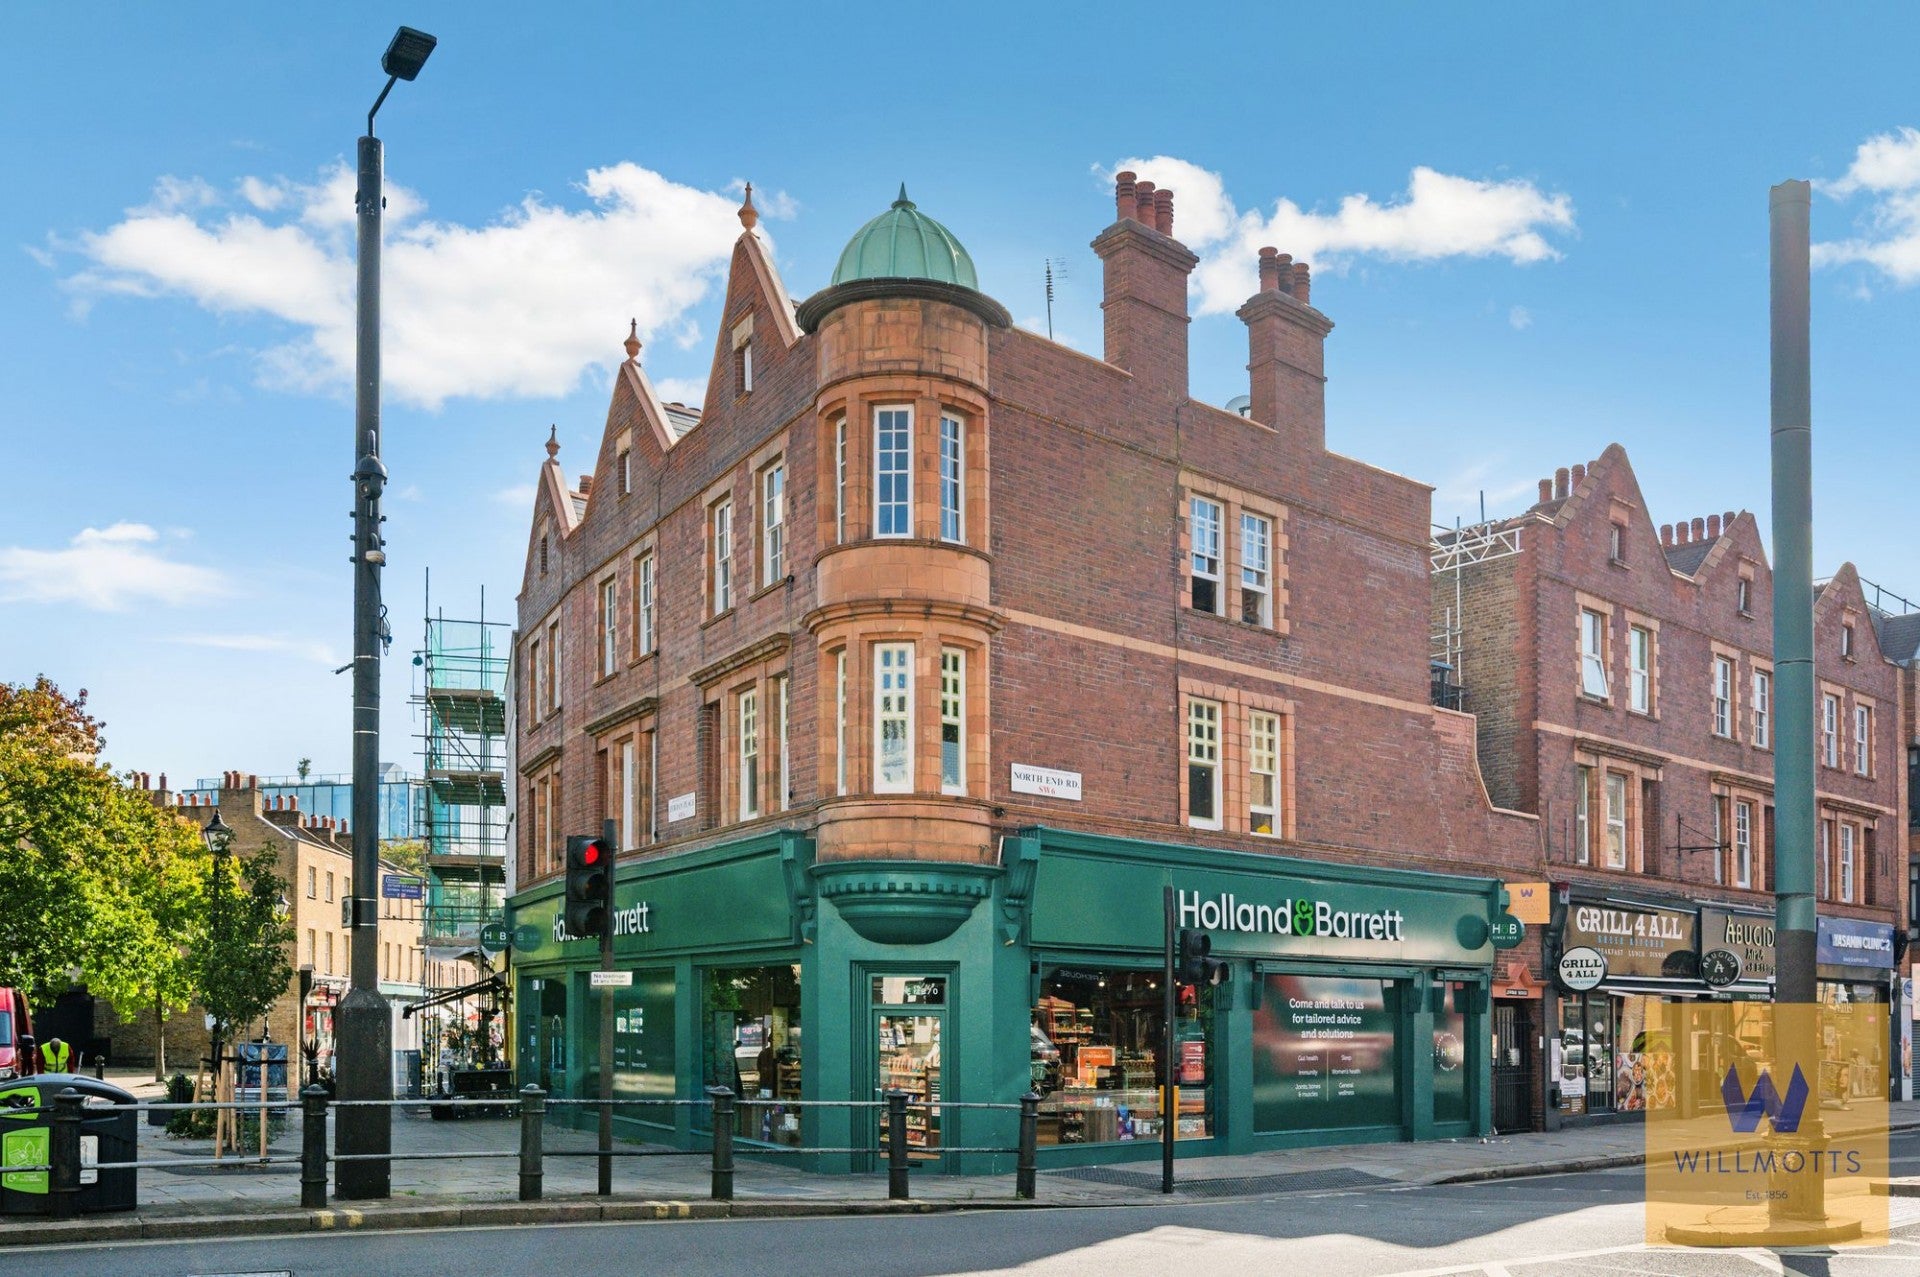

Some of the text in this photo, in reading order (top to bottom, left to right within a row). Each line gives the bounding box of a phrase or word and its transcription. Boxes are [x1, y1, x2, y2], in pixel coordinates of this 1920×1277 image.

[1014, 771, 1043, 783] NORTH
[1045, 776, 1063, 786] END
[1065, 780, 1080, 789] RD.
[1576, 906, 1683, 940] GRILL 4 ALL
[1725, 915, 1775, 948] ABUGID
[1561, 959, 1602, 969] GRILL
[1702, 951, 1737, 969] ABUGIDA
[1566, 970, 1597, 978] 4 ALL
[1289, 998, 1364, 1010] Come and talk to us
[1292, 1013, 1361, 1024] for tailored advice
[1301, 1028, 1354, 1039] and solutions
